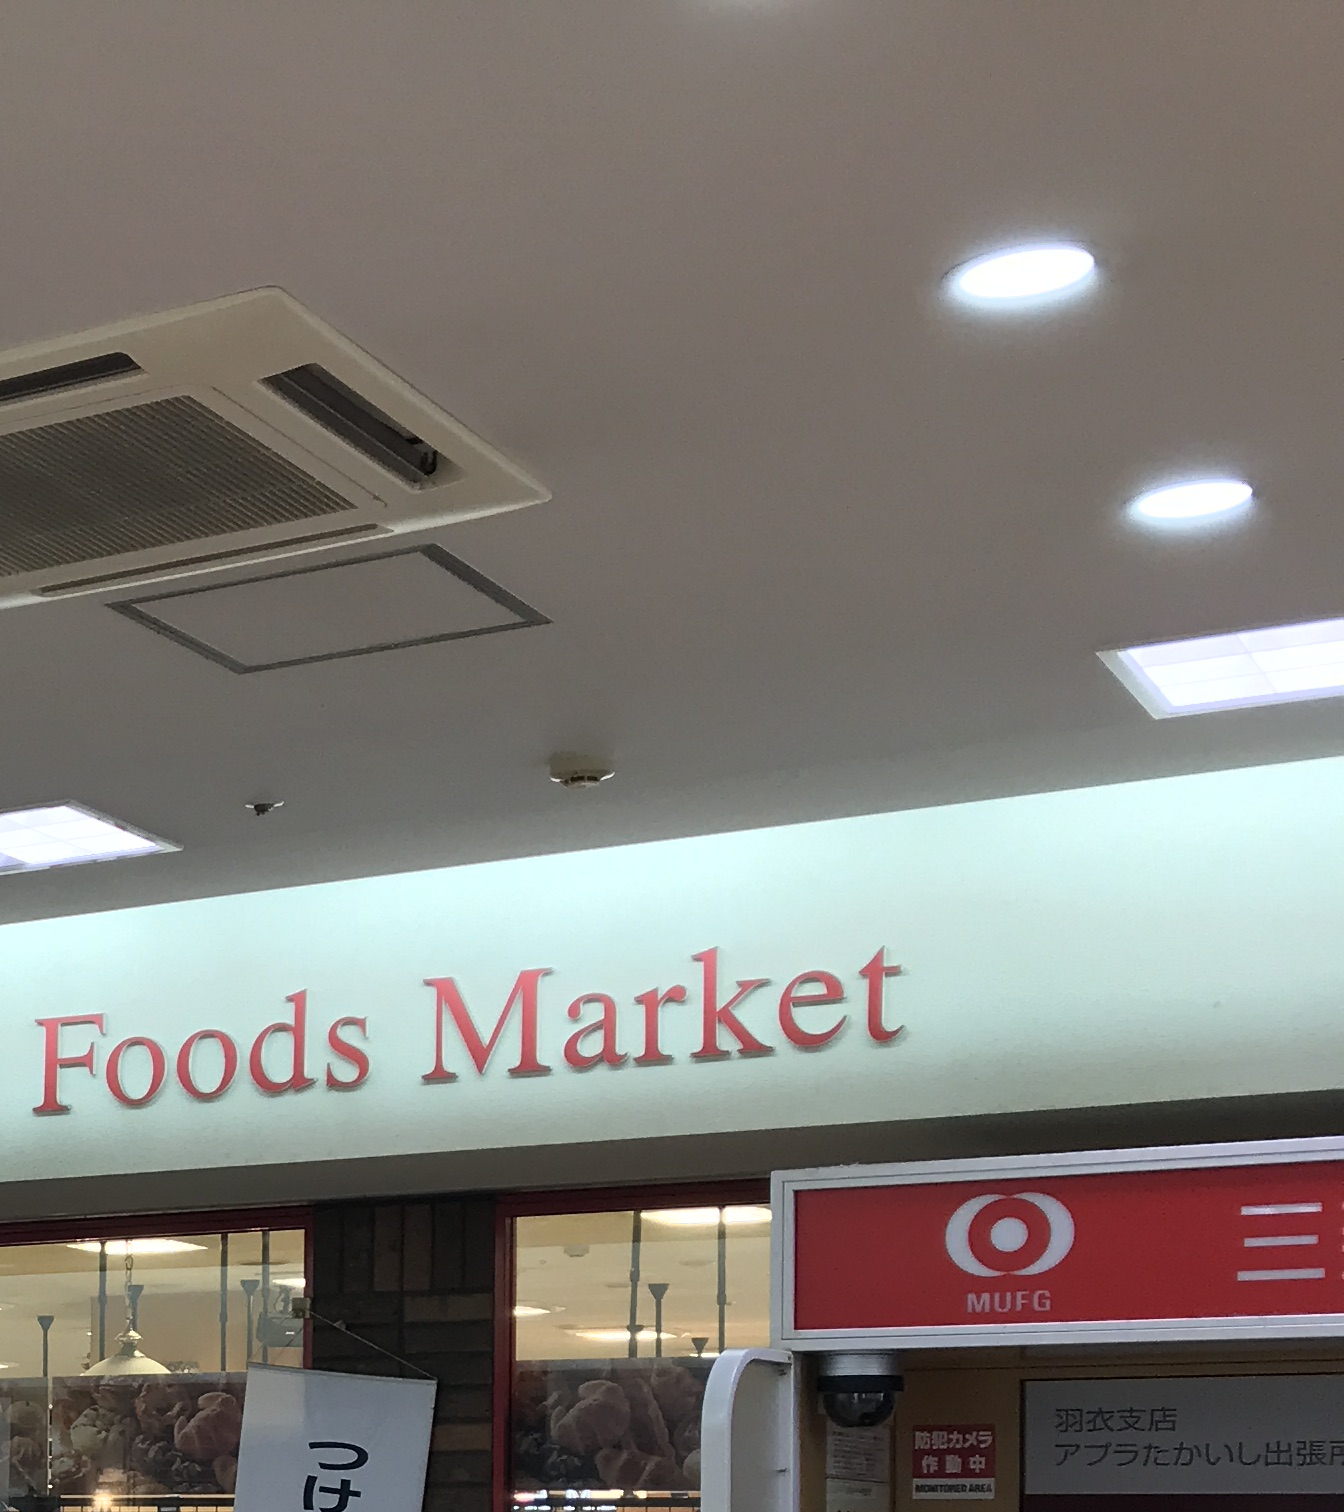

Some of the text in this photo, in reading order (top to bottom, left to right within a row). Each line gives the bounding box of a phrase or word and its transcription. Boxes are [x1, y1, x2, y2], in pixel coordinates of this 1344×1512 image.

[33, 988, 371, 1115] Foods
[422, 945, 905, 1084] Market
[966, 1291, 1051, 1313] MUFG
[1054, 1406, 1178, 1433] 羽衣支店
[915, 1431, 993, 1449] 防犯カメラ
[922, 1454, 986, 1473] 作動中
[969, 1484, 993, 1493] AREA
